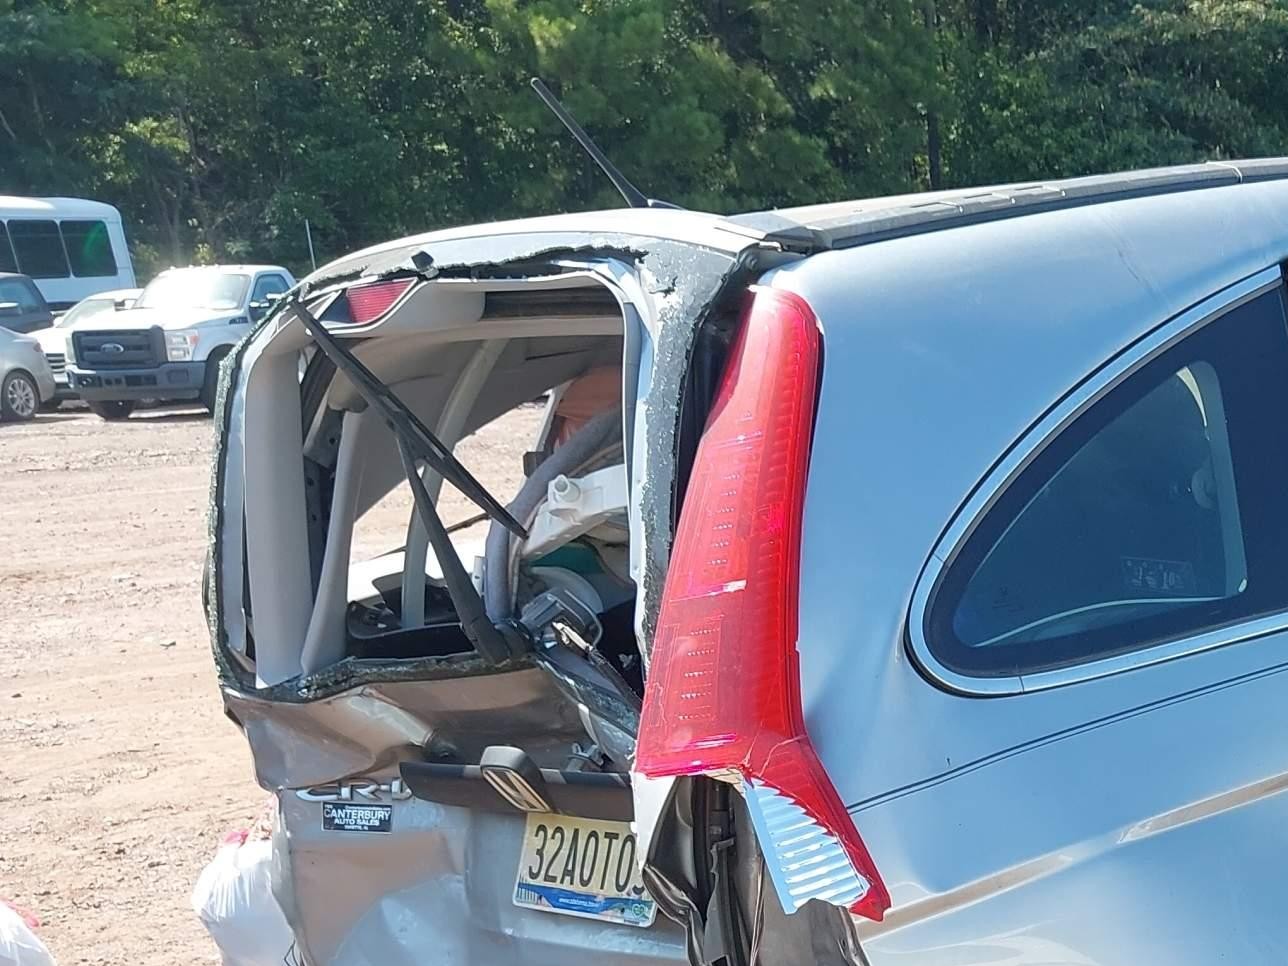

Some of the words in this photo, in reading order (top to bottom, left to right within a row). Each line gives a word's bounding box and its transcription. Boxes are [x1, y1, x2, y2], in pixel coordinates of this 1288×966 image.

[324, 808, 391, 821] CANTERBURY
[357, 818, 380, 826] SALES
[528, 824, 645, 895] 32A0T0
